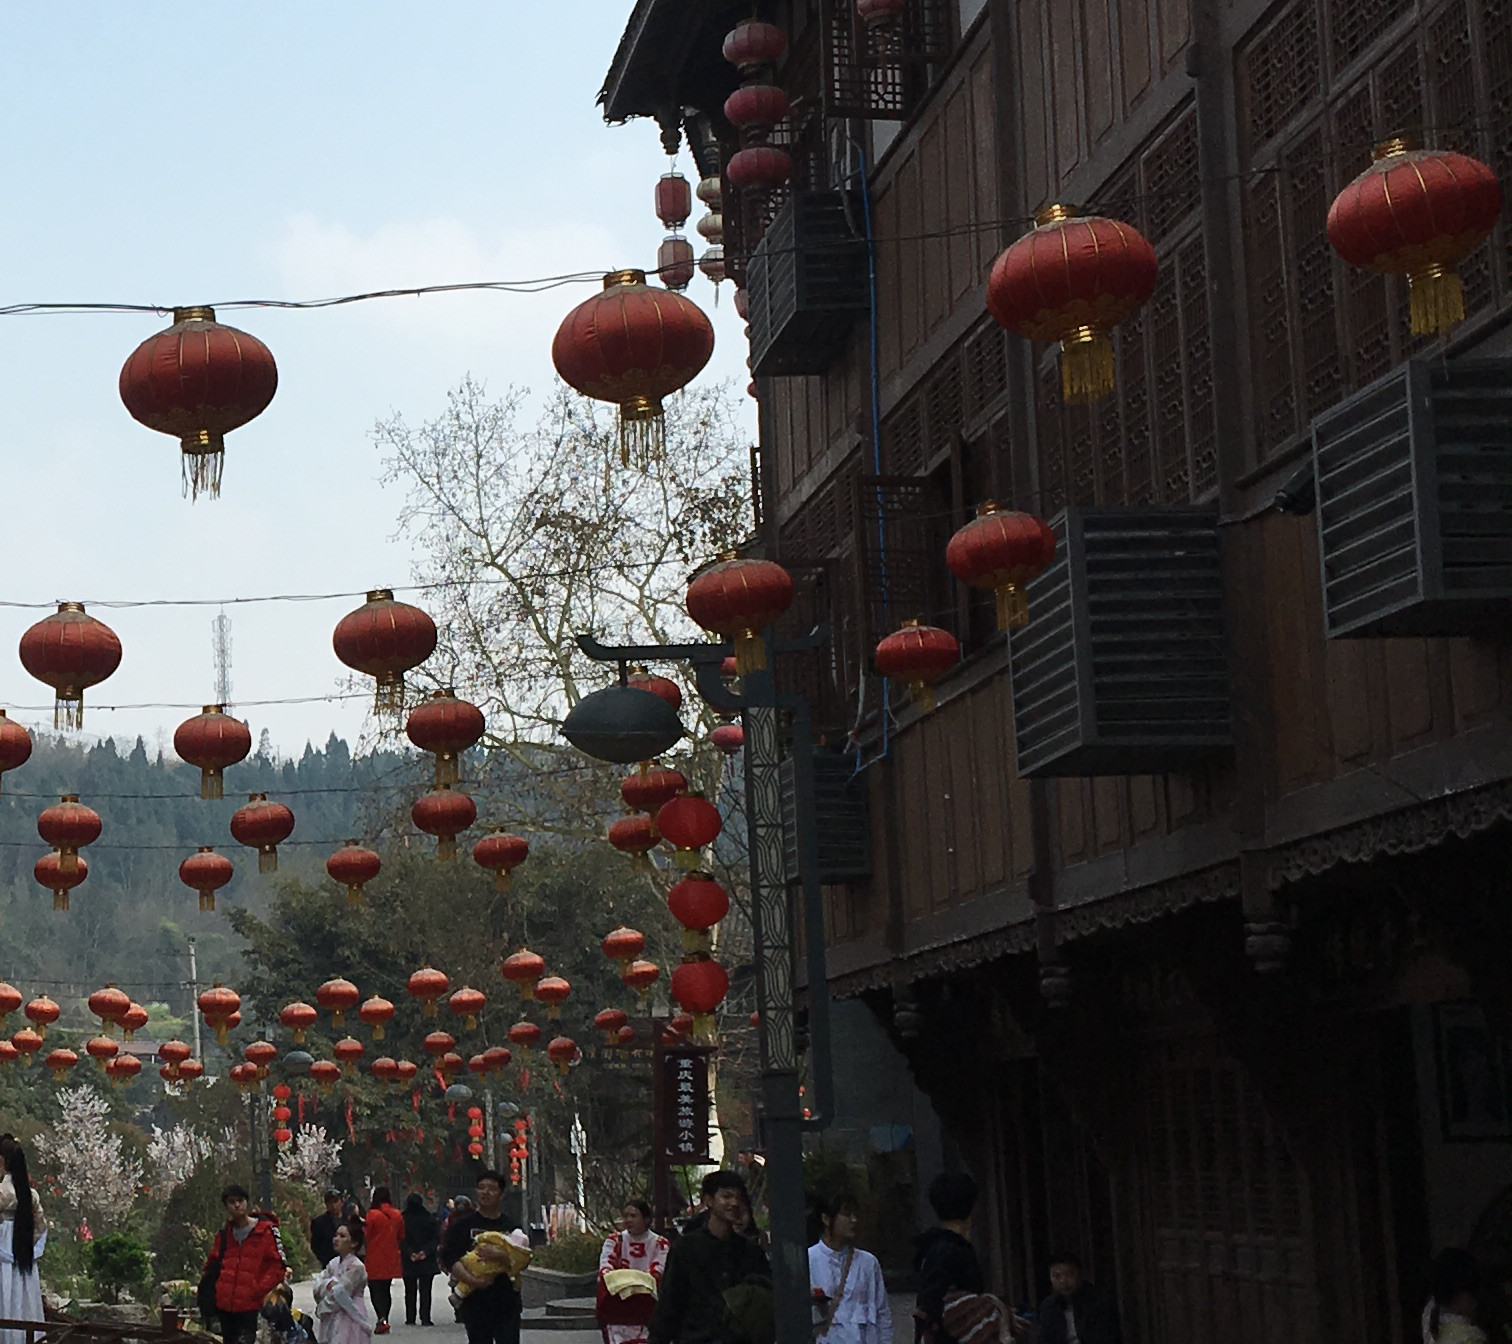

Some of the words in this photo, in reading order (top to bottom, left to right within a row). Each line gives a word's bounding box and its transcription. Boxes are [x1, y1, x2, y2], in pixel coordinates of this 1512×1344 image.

[677, 1058, 695, 1153] 重庆最美旅游小镇
